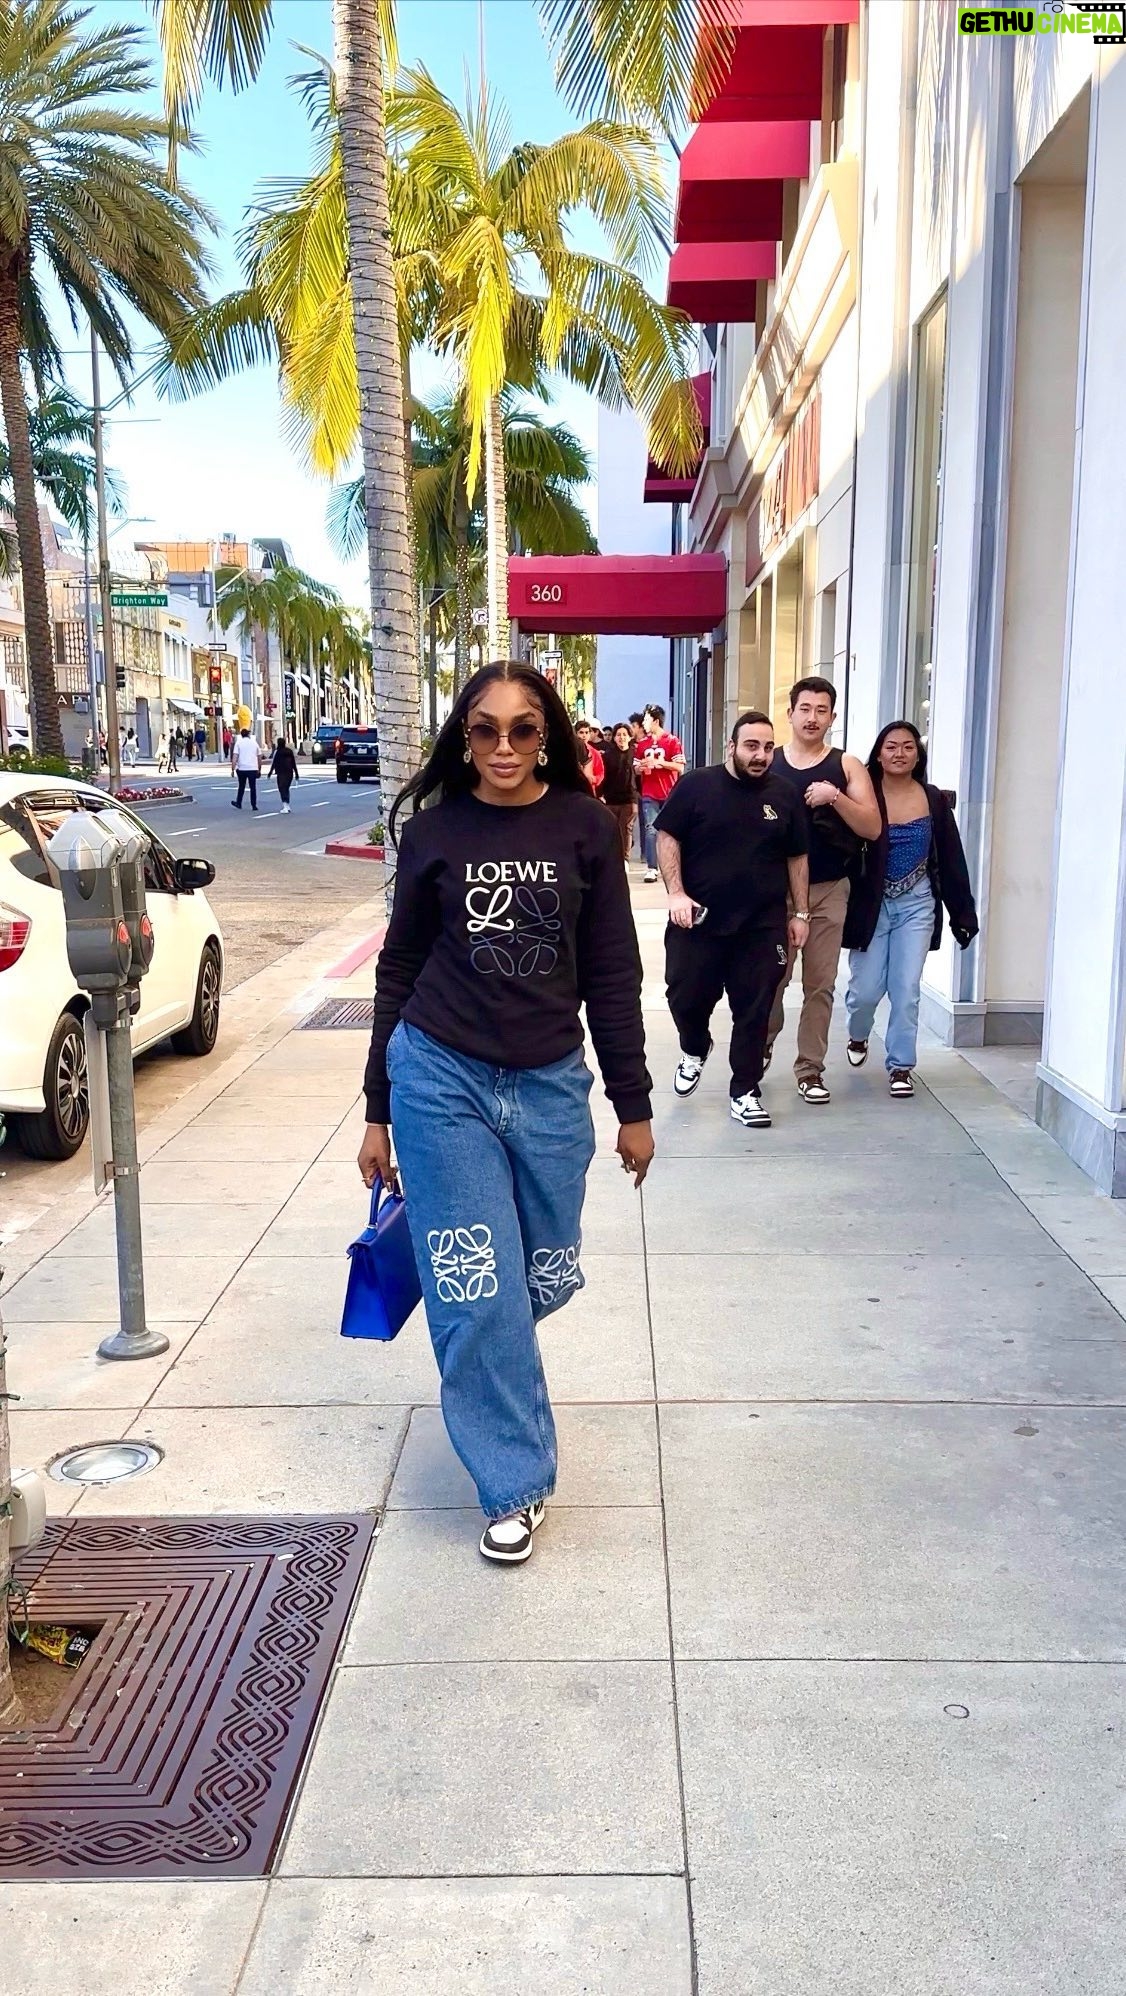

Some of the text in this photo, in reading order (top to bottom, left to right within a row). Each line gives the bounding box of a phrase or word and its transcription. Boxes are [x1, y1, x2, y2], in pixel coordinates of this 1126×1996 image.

[113, 597, 166, 606] Brighton Way
[531, 584, 562, 602] 360
[465, 861, 558, 884] LOEWE
